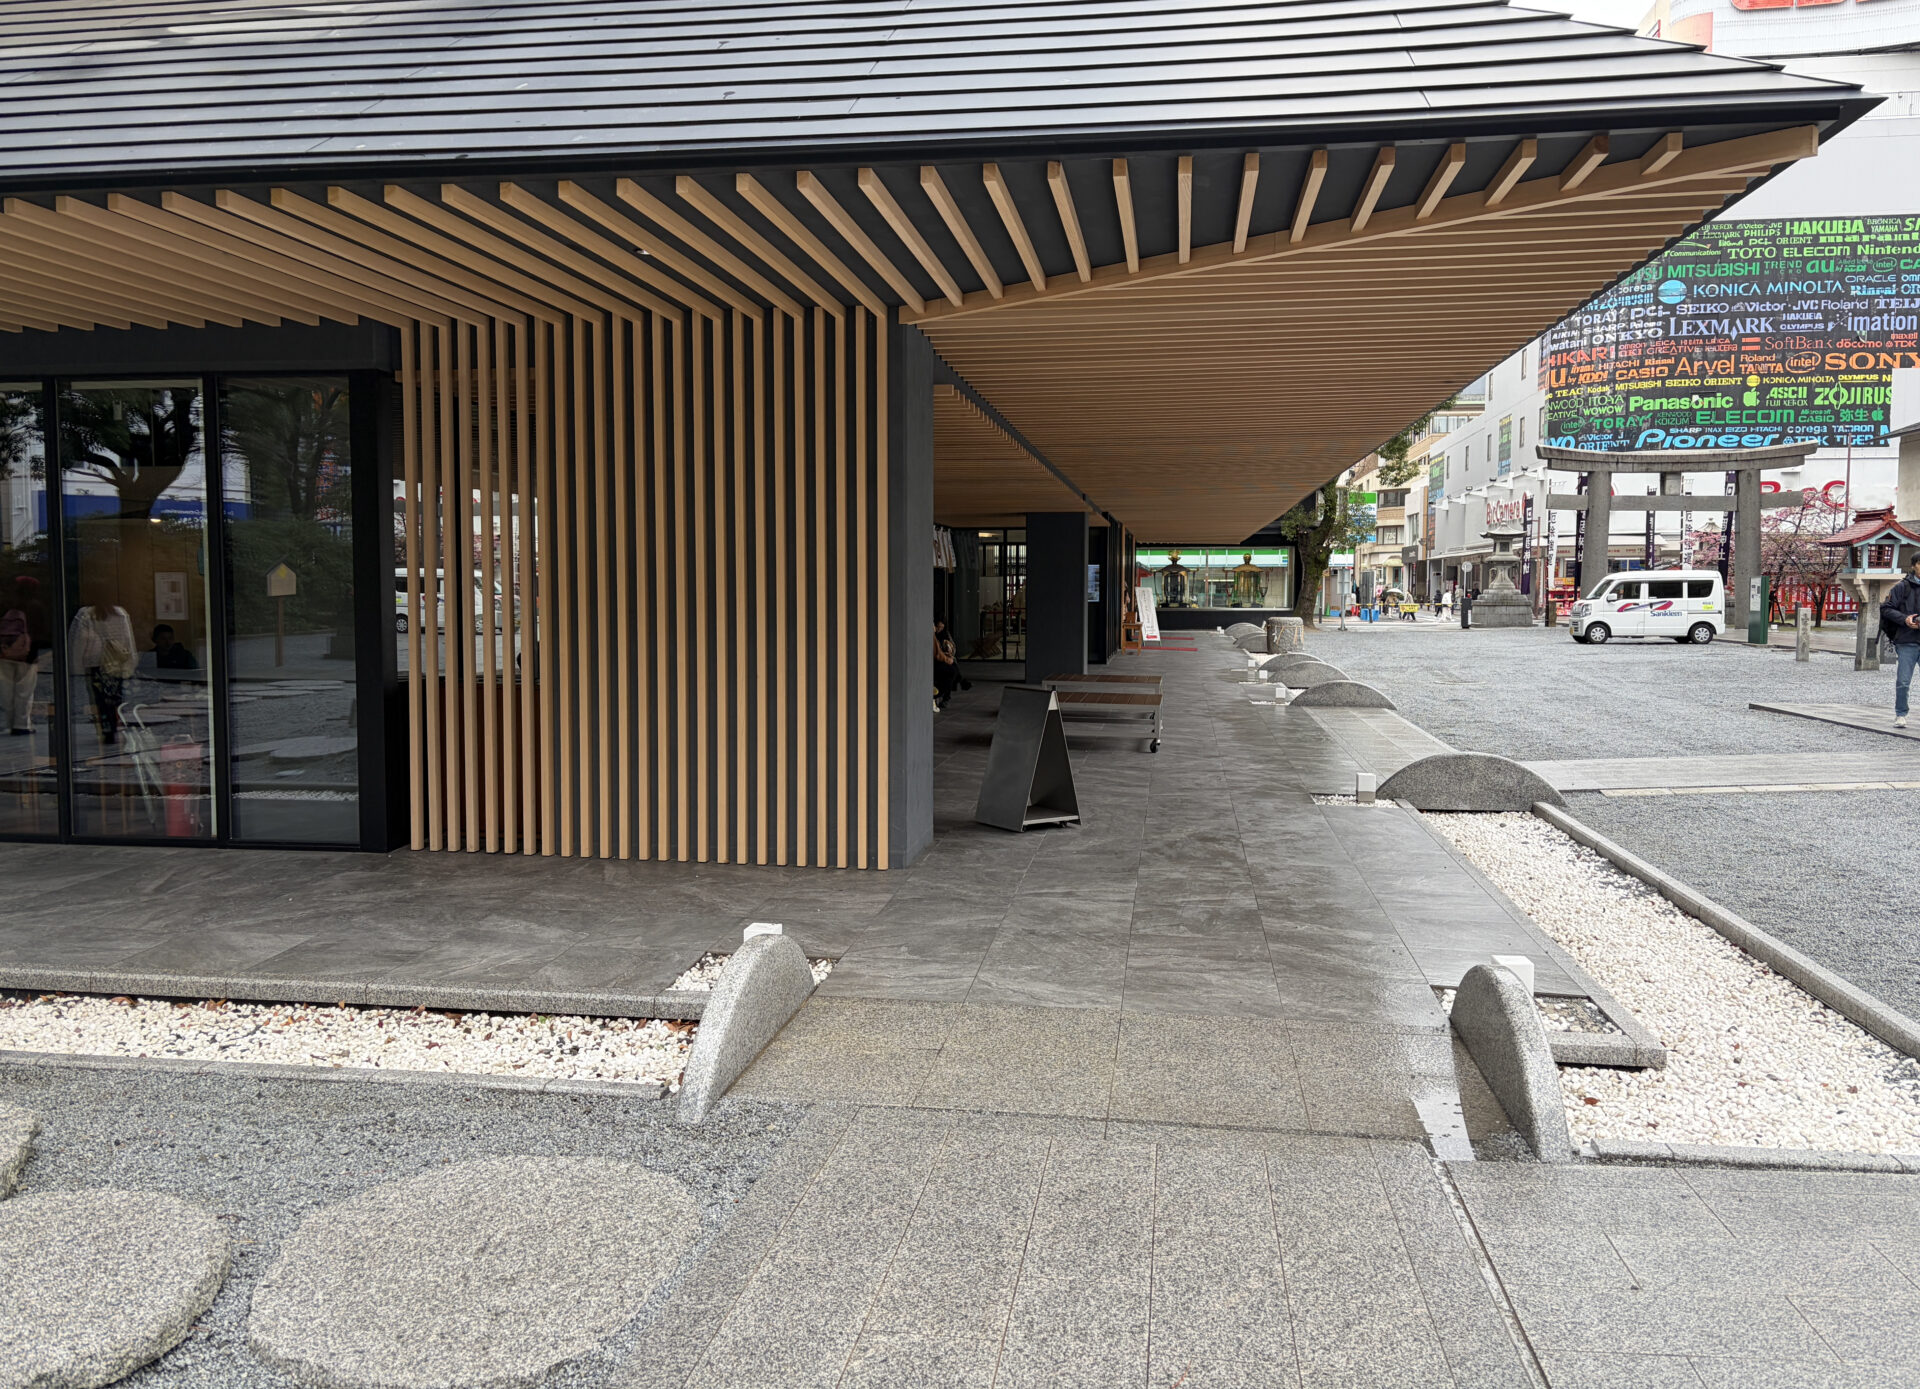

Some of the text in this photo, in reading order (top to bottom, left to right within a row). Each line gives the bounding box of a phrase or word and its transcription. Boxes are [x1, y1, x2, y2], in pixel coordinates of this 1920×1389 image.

[1744, 228, 1780, 237] PHILIPS
[1786, 220, 1865, 235] HAKUBA
[1871, 224, 1898, 232] YAMAHA
[1776, 236, 1813, 244] ORIENT
[1728, 246, 1777, 260] TOTO
[1667, 262, 1760, 278] MITSUBISHI
[1764, 260, 1802, 269] TREND
[1806, 259, 1834, 274] au
[1844, 274, 1897, 283] ORACLE
[1693, 280, 1842, 298] KONICA MINOLTA
[1676, 302, 1730, 315] SEIKO
[1744, 300, 1819, 312] Victor JVC
[1820, 298, 1868, 310] Roland
[1780, 322, 1825, 330] OLYMPUS
[1848, 312, 1918, 331] imation
[1582, 322, 1626, 335] SHARP
[1668, 316, 1776, 340] LEXMARK
[1592, 328, 1663, 346] ONKYO
[1764, 335, 1832, 350] SoftBank
[1646, 345, 1702, 356] CREATIVE
[1740, 352, 1776, 362] Roland
[1598, 360, 1640, 370] HITACHI
[1674, 354, 1735, 376] Arvel
[1616, 366, 1669, 380] CASIO
[1615, 380, 1662, 390] MITSUBISHI
[1666, 378, 1701, 387] SEIKO
[1704, 377, 1743, 386] ORIENT
[1762, 376, 1835, 384] KONICA MINOLTA
[1555, 388, 1584, 398] TEAC
[1587, 384, 1610, 394] Kodak
[1767, 386, 1808, 399] ASCII
[1630, 392, 1734, 412] Panasonic
[1583, 405, 1624, 416] WOWOW
[1591, 414, 1650, 430] TORAY
[1787, 425, 1828, 434] corega
[1635, 428, 1780, 448] Pioneer
